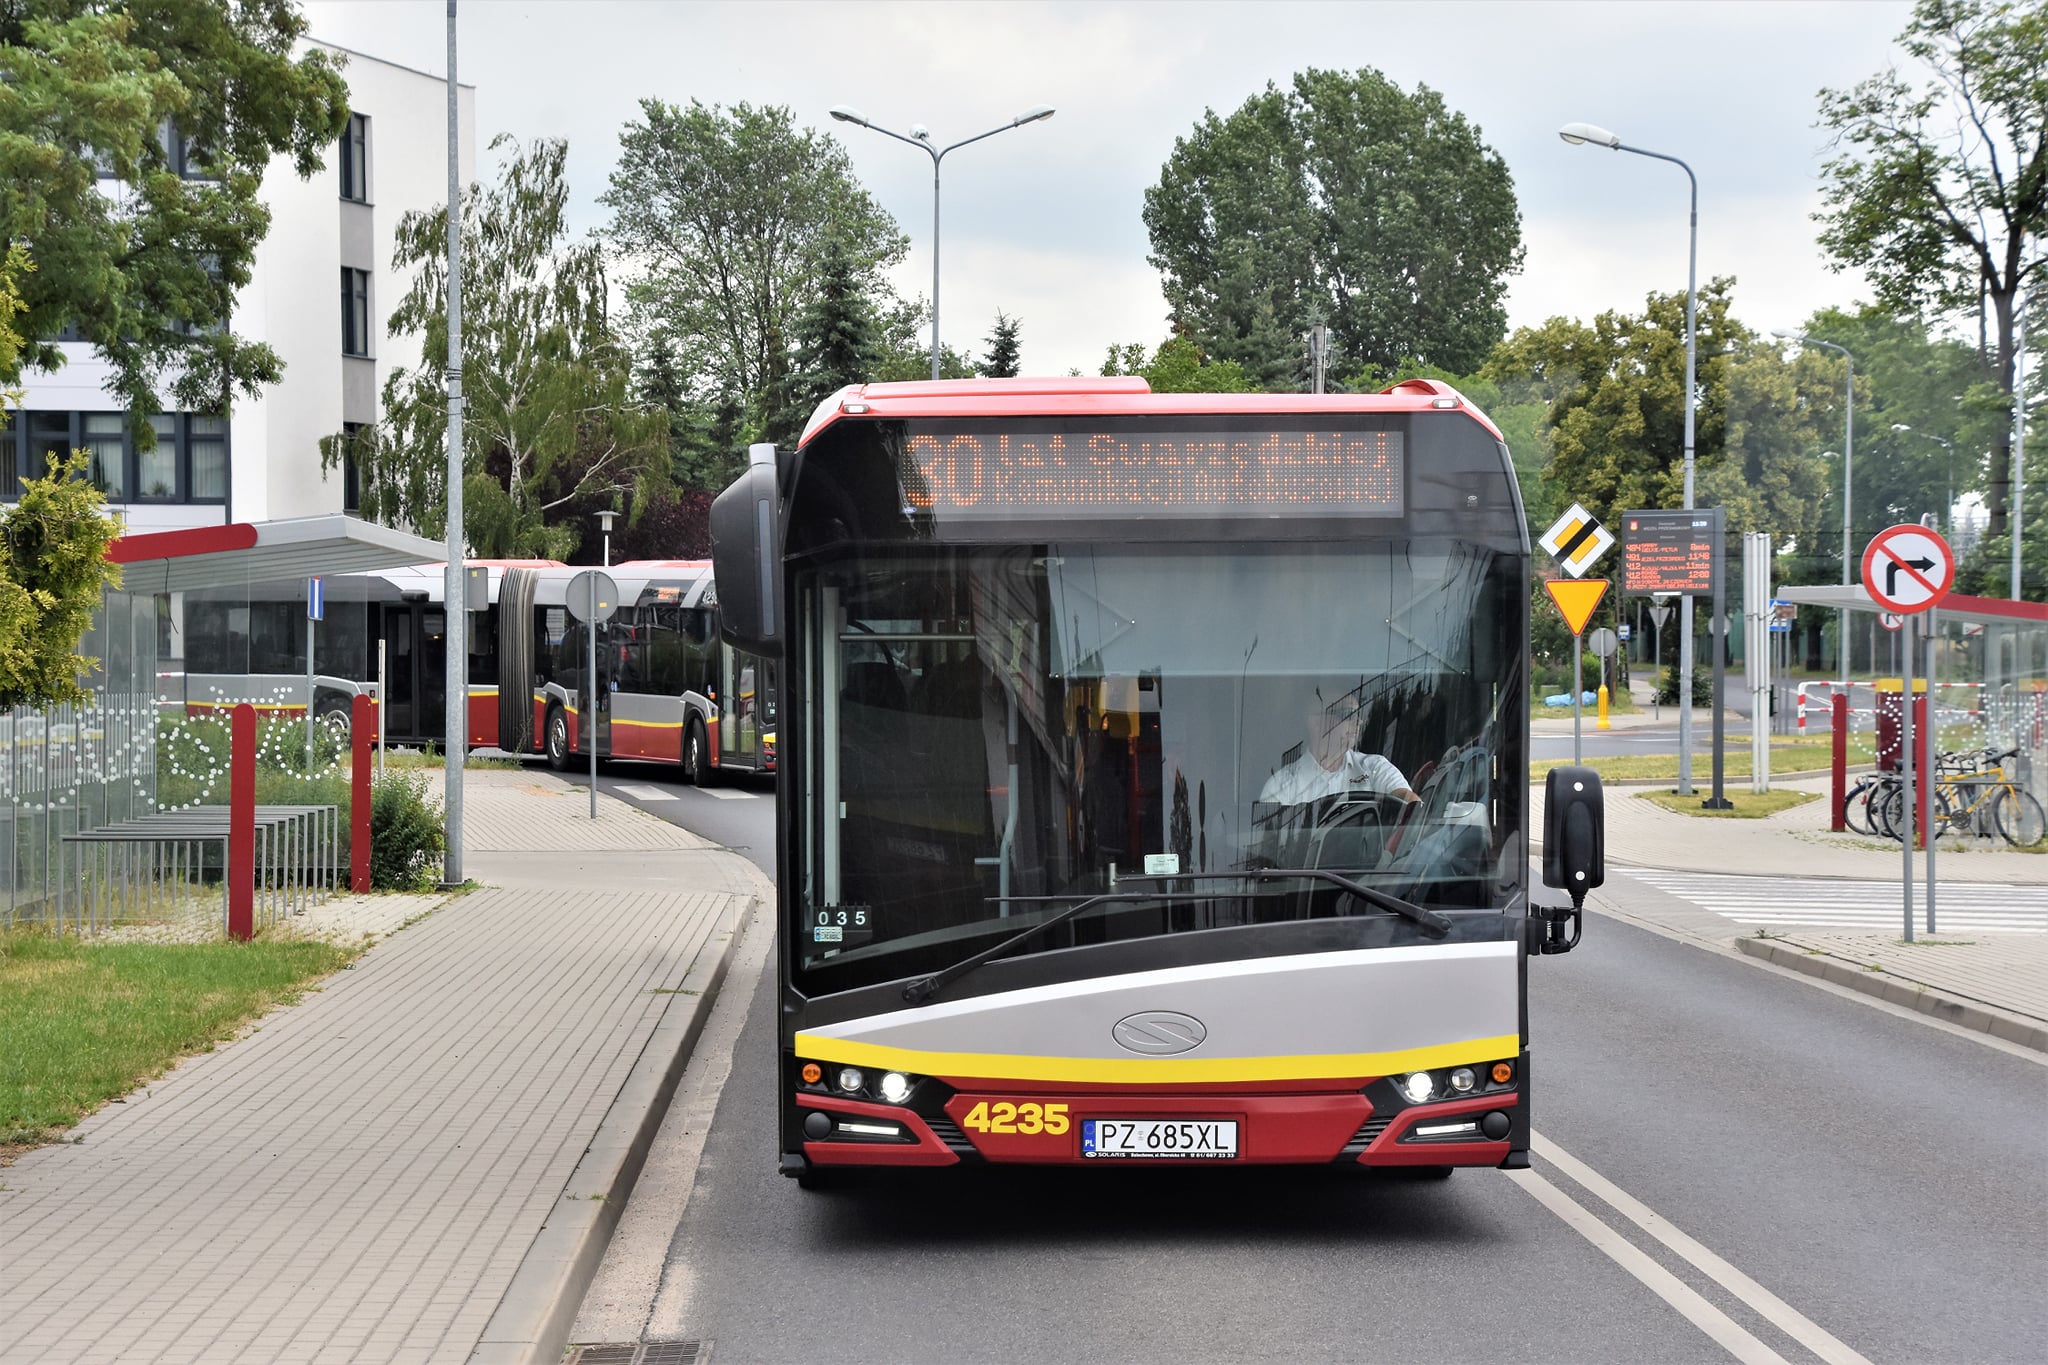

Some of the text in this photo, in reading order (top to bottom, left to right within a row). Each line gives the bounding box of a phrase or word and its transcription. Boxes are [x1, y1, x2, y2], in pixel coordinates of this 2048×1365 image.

[906, 434, 982, 506] 30
[1000, 434, 1067, 466] lat
[995, 469, 1182, 505] Komunikacji
[1626, 562, 1641, 570] 412
[1626, 571, 1641, 580] 412
[963, 1102, 1070, 1135] 4235
[1102, 1123, 1136, 1149] PZ
[1146, 1123, 1229, 1150] 685XL
